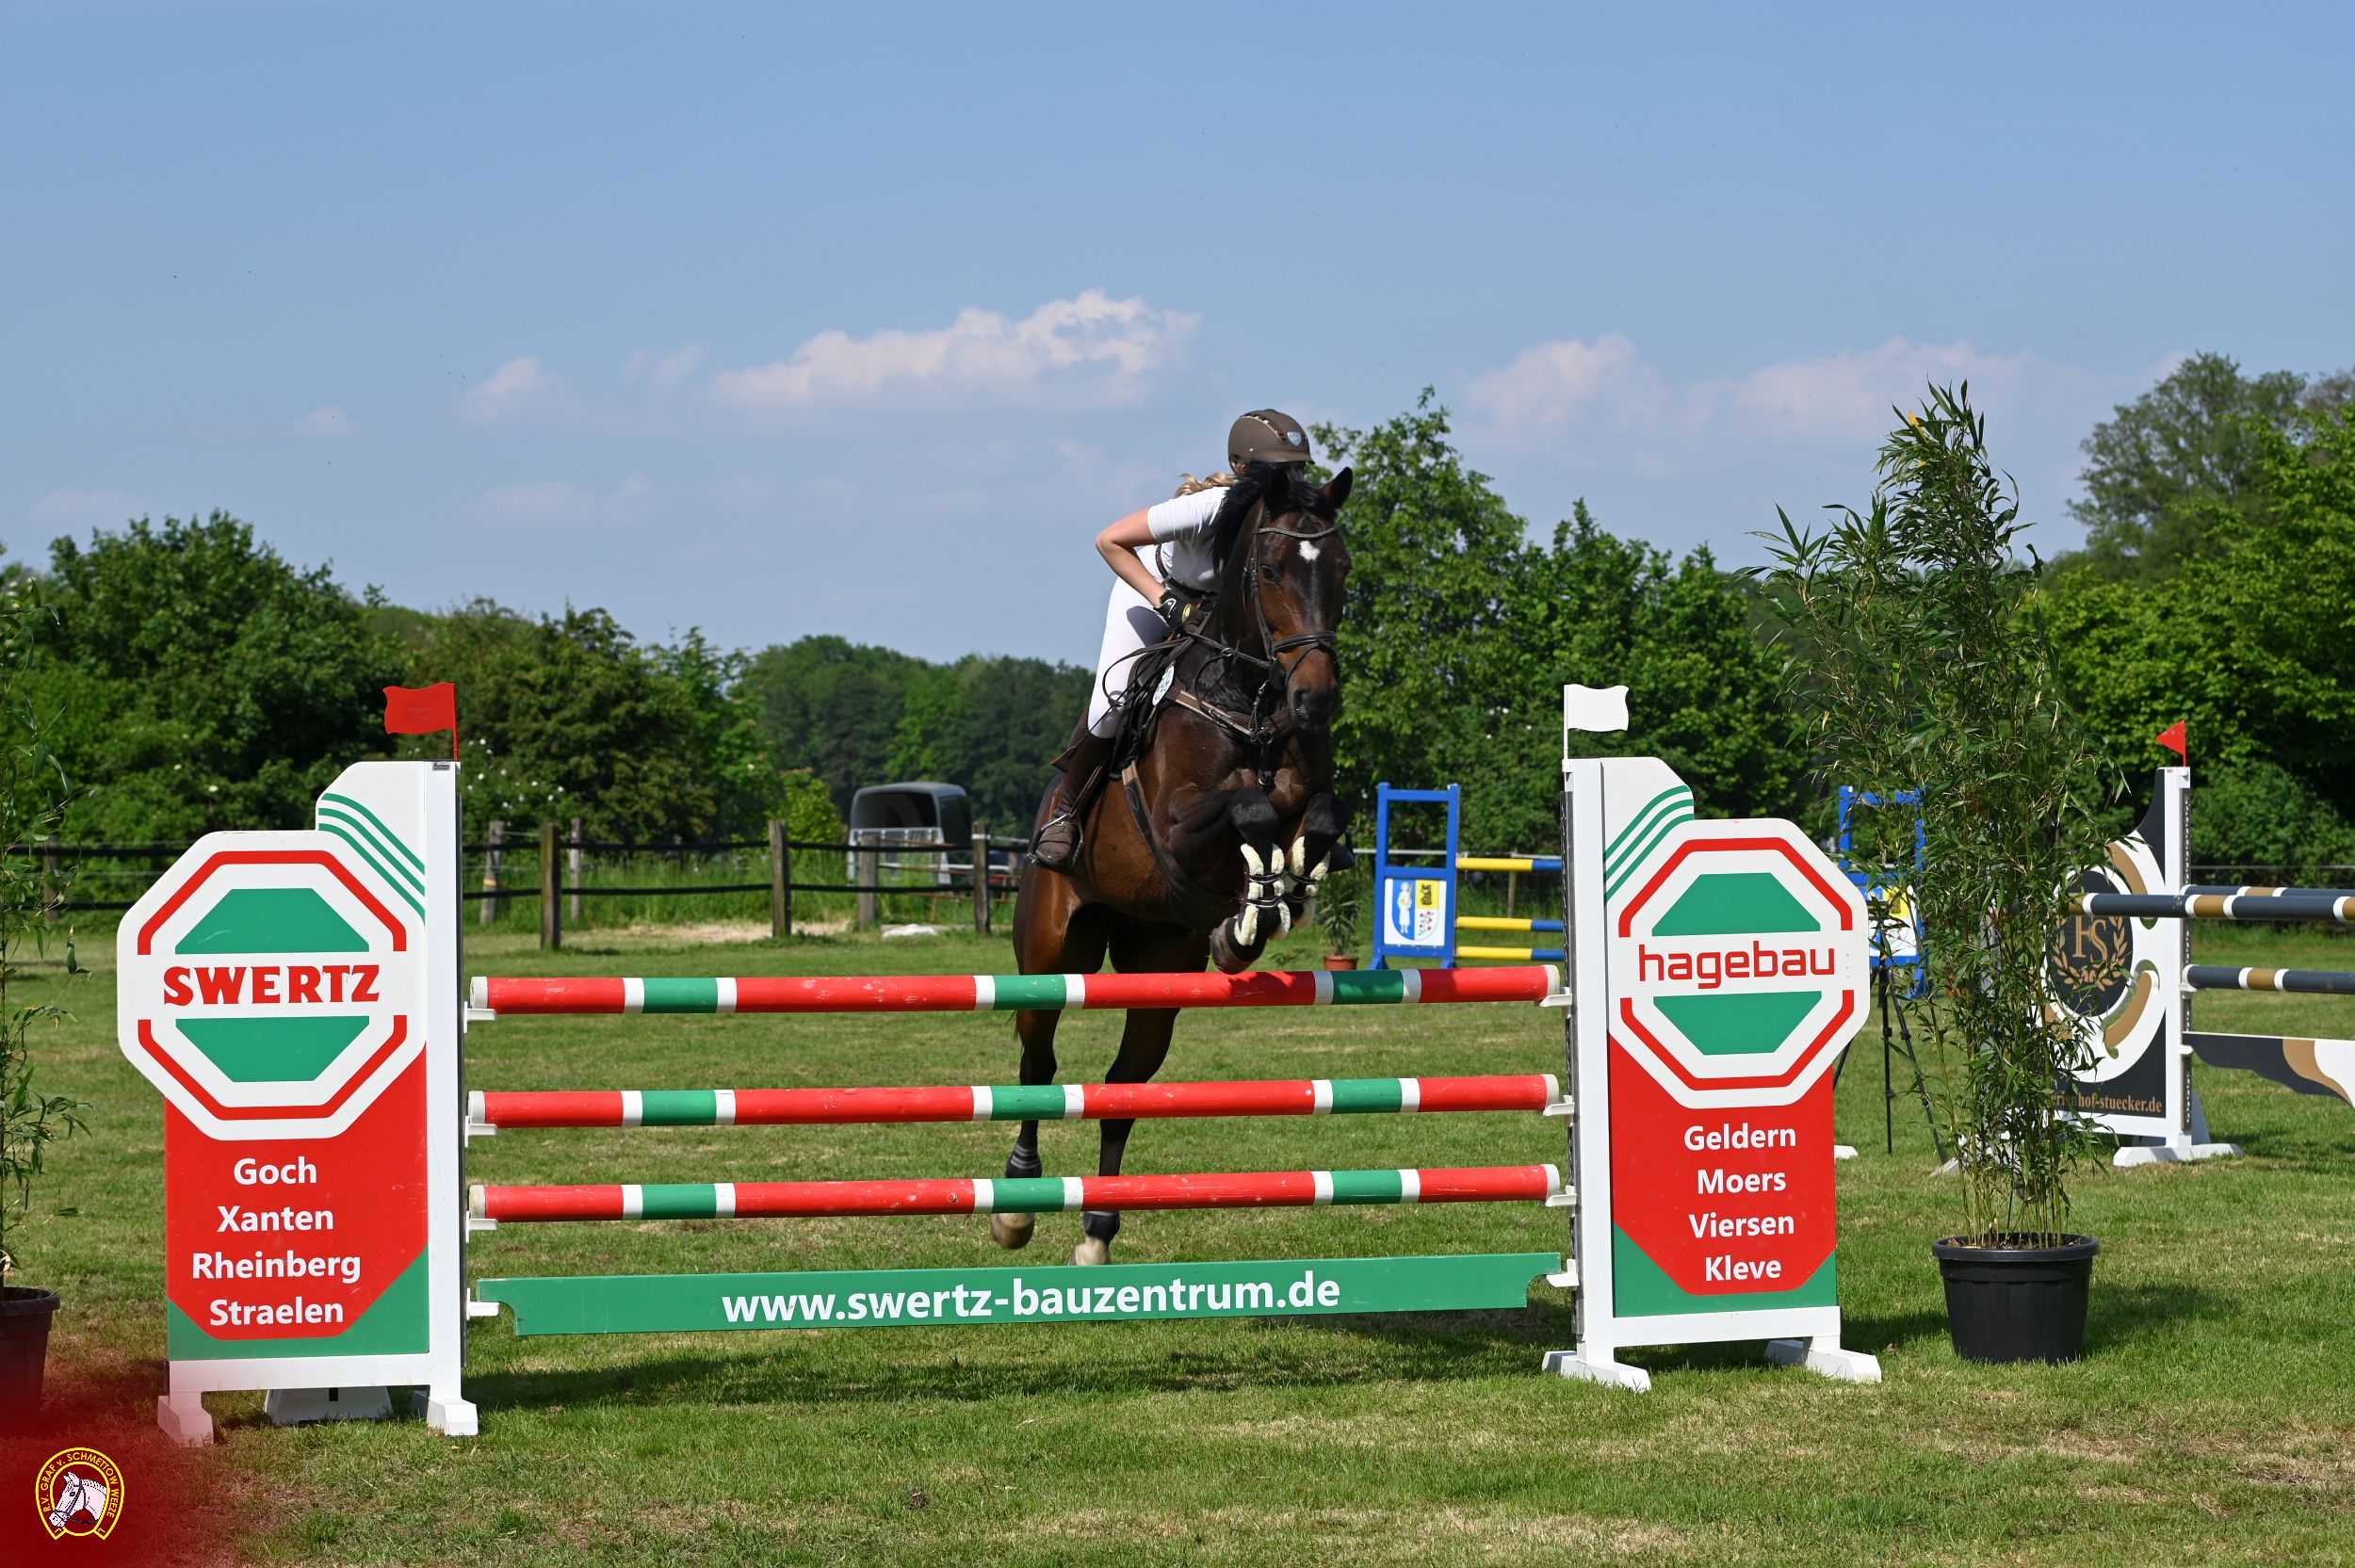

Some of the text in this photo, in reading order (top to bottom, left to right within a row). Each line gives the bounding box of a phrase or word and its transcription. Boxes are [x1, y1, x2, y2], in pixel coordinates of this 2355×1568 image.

[1638, 940, 1835, 990] hagebau
[163, 964, 380, 1007] SWERTZ
[1683, 1122, 1796, 1151] Geldern
[234, 1156, 317, 1186] Goch
[1697, 1169, 1787, 1194] Moers
[218, 1205, 333, 1233] Xanten
[1688, 1211, 1795, 1238] Viersen
[192, 1250, 361, 1284] Rheinberg
[1705, 1254, 1782, 1282] Kleve
[210, 1296, 344, 1326] Straelen
[722, 1270, 1340, 1323] www.swertz-bauzentrum.de
